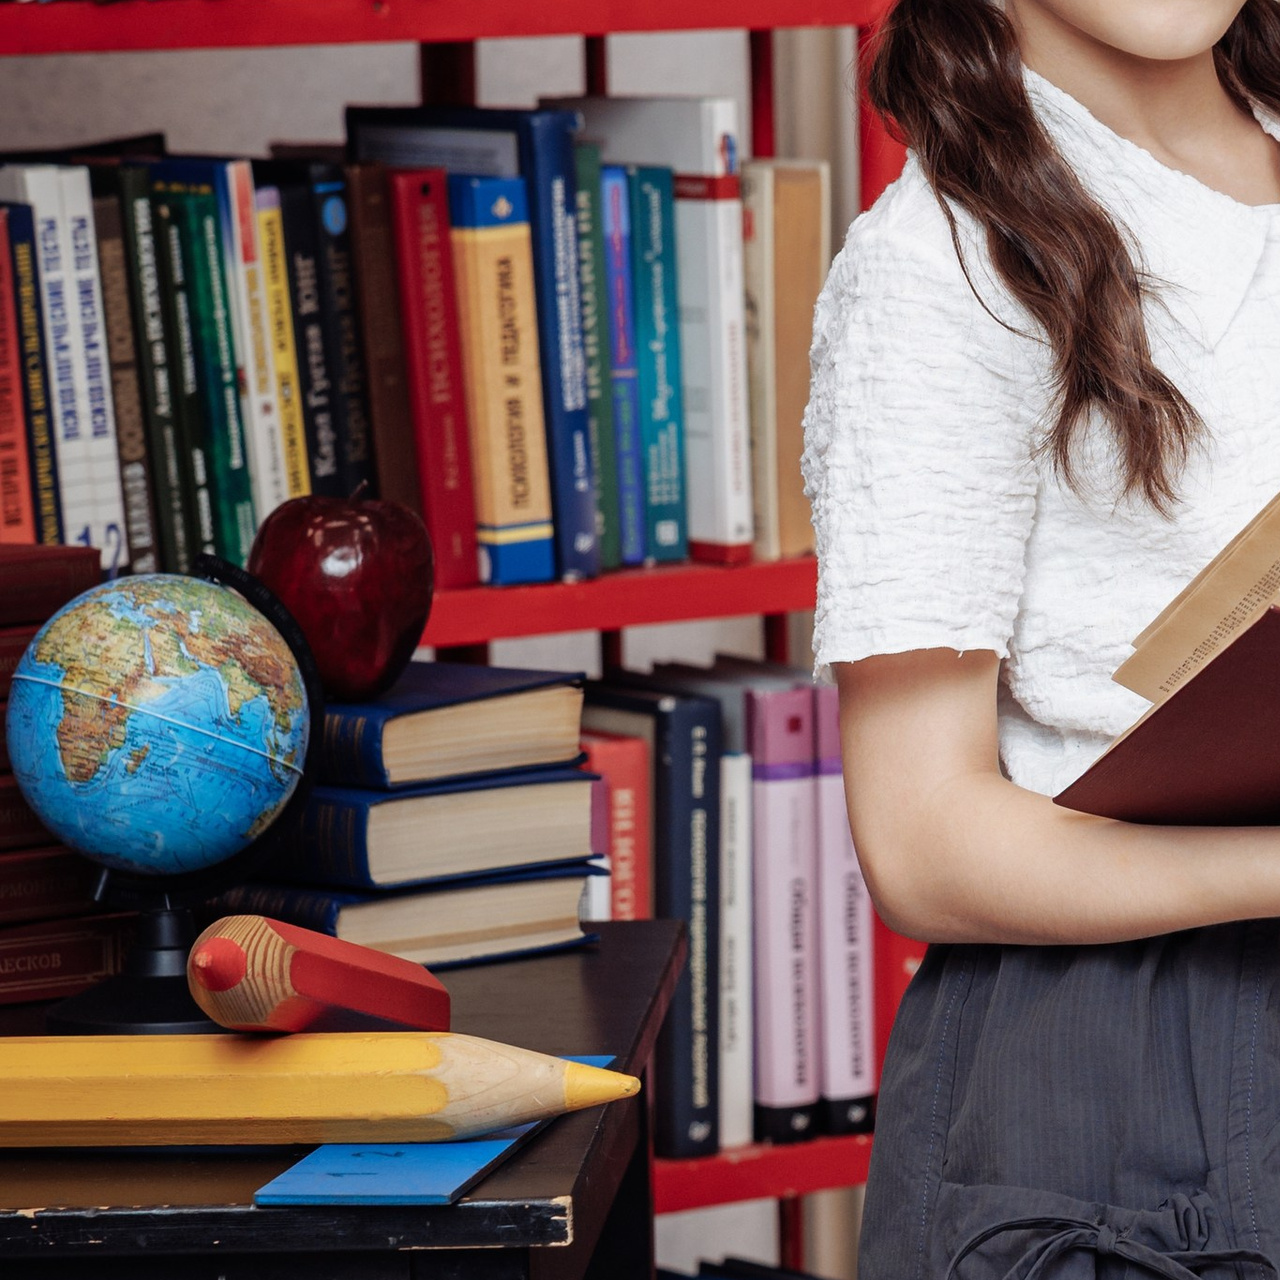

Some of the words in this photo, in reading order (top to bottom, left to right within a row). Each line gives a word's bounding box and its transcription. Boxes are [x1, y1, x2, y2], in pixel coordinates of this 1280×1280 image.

[39, 218, 61, 271] ТЕСТЫ
[69, 217, 90, 269] ТЕСТЫ
[291, 251, 319, 315] ЮНГ
[411, 202, 454, 404] ПСИХОЛОГИЯ
[494, 257, 520, 365] ПЕДАГОГИКА
[298, 323, 332, 407] Густав
[503, 374, 520, 388] И
[307, 411, 339, 477] Карл
[504, 397, 529, 507] ПСИХОЛОГИЯ
